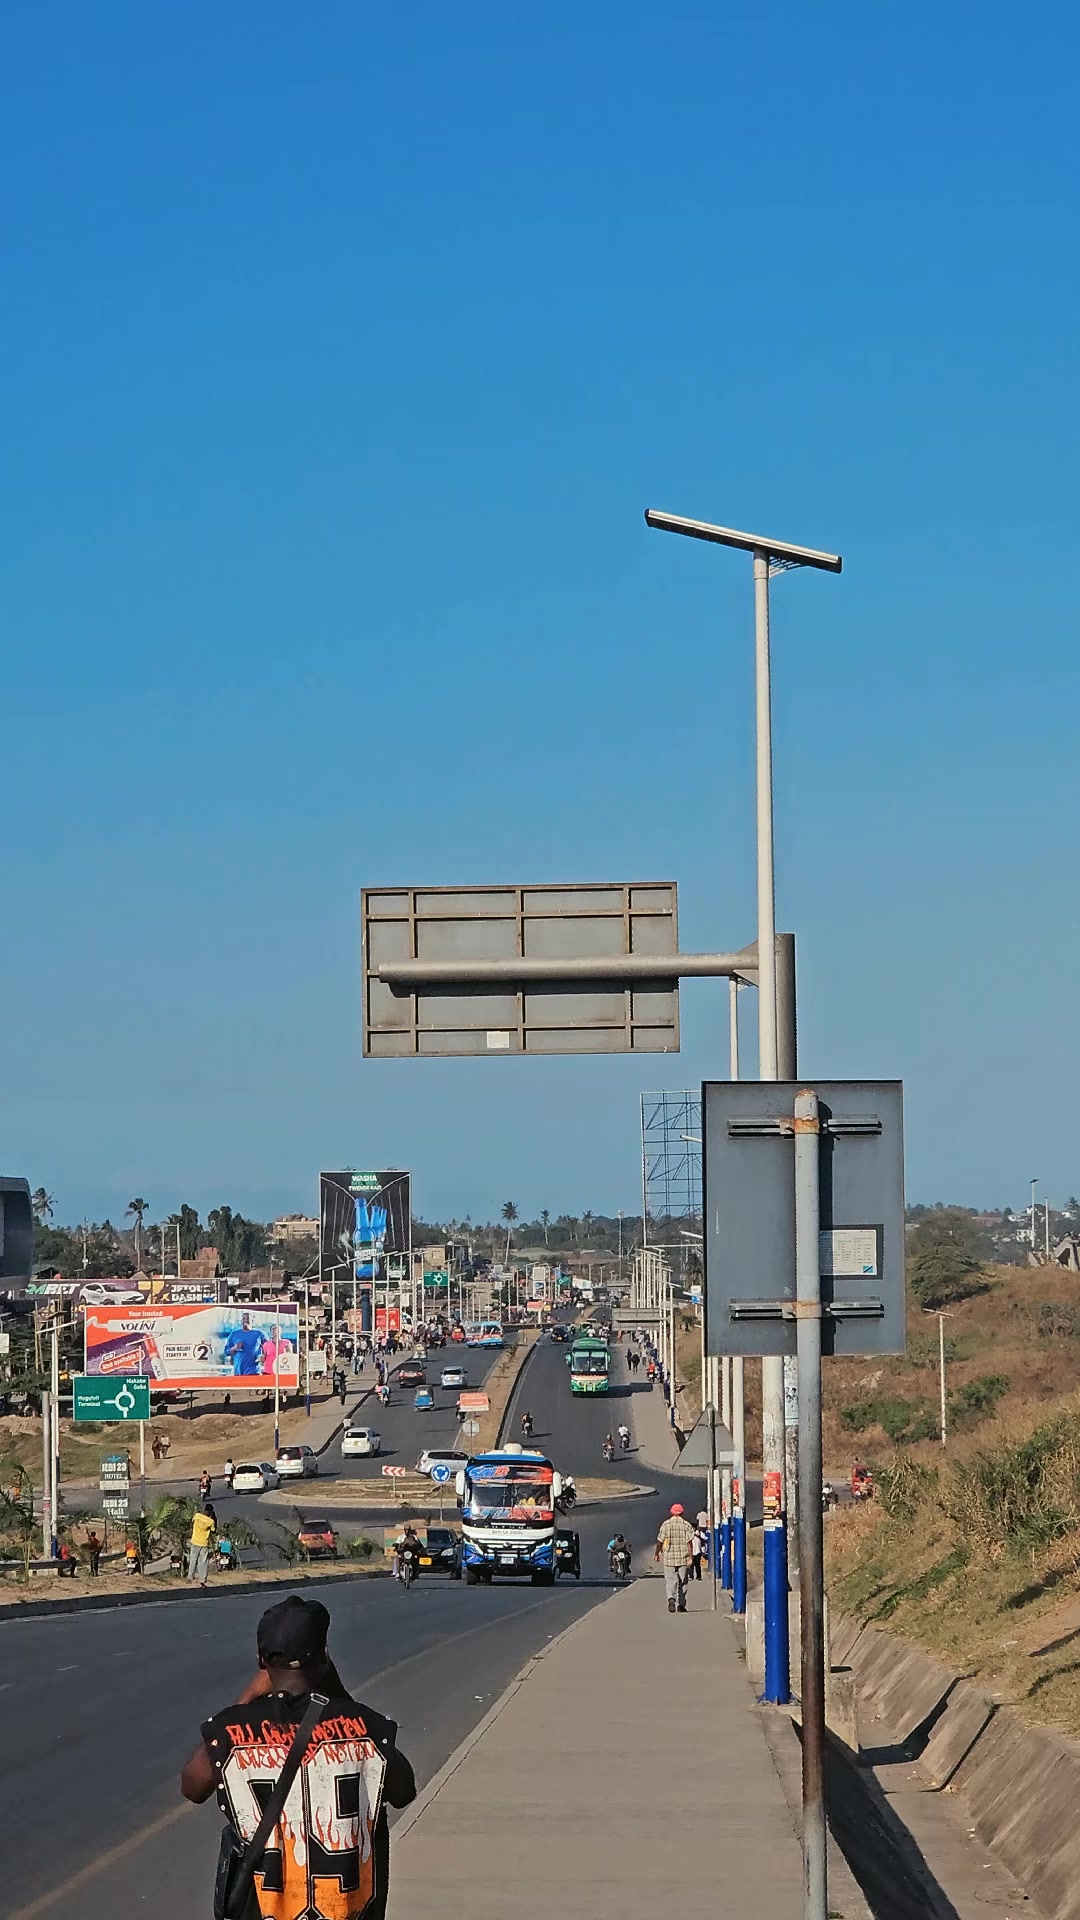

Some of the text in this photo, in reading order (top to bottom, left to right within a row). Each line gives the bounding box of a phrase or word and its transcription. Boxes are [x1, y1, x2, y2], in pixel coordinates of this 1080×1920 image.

[197, 1346, 209, 1361] 2
[116, 1463, 127, 1472] 23
[118, 1499, 128, 1507] 23
